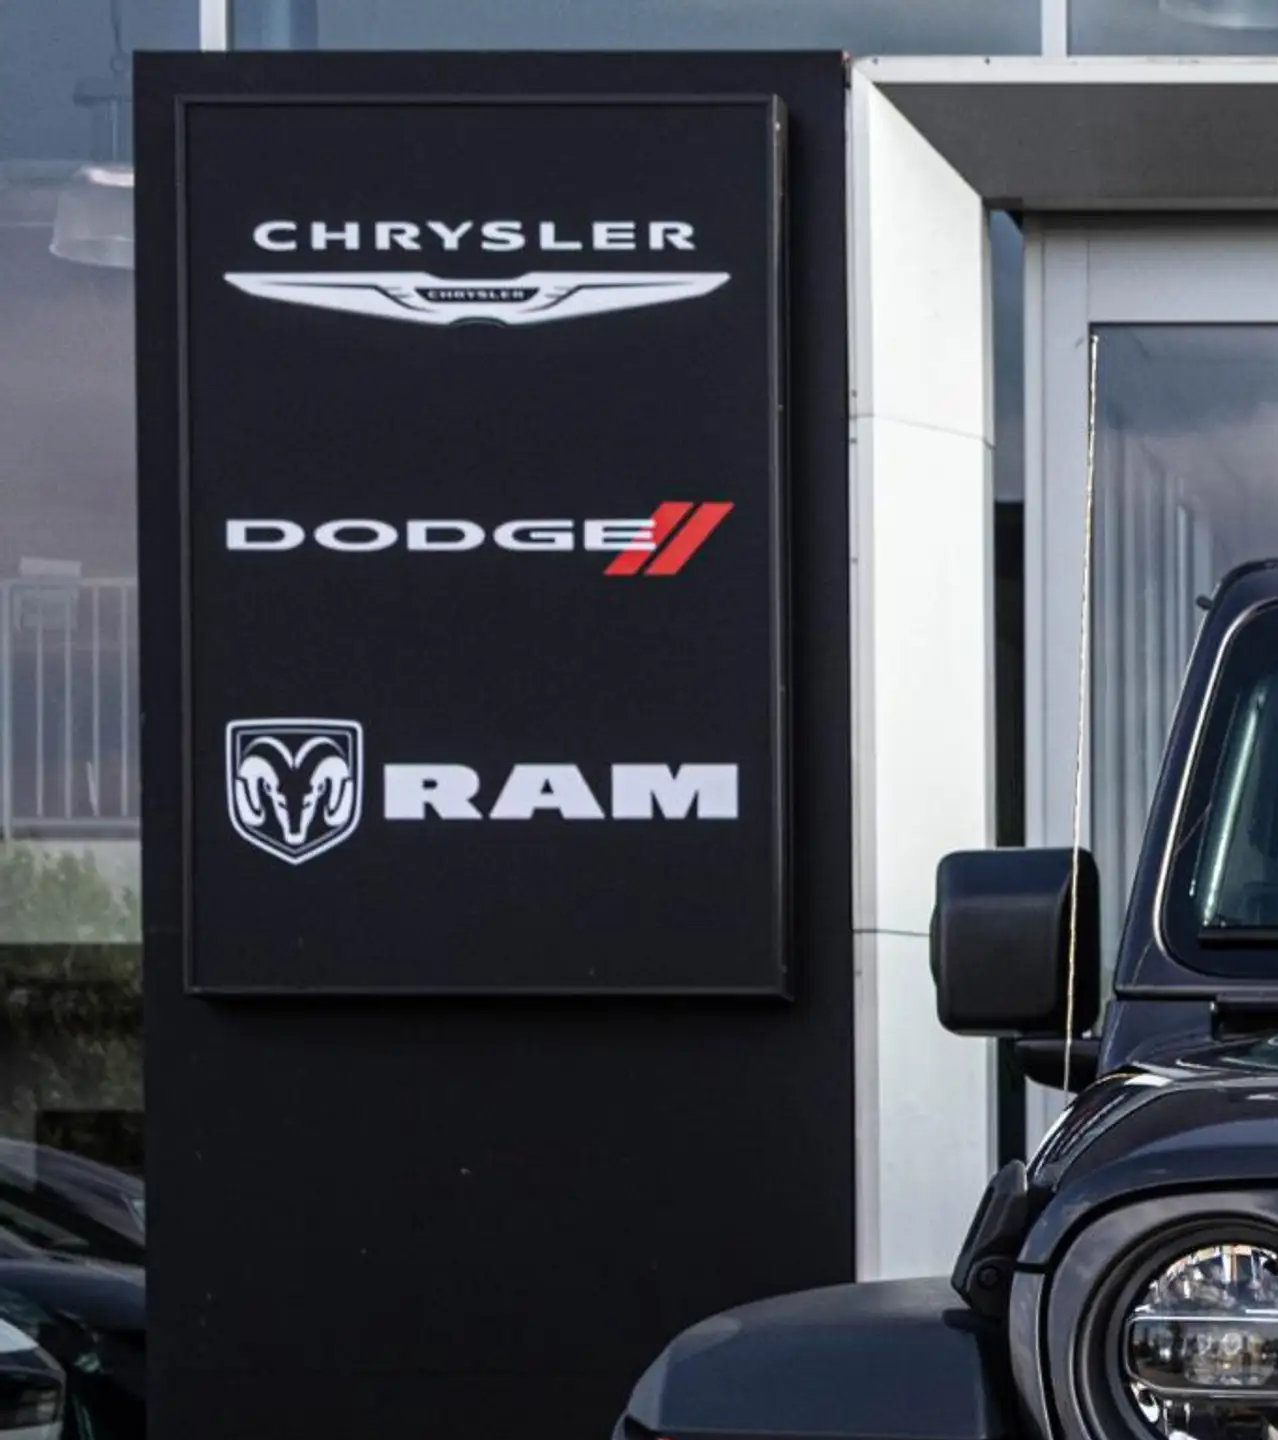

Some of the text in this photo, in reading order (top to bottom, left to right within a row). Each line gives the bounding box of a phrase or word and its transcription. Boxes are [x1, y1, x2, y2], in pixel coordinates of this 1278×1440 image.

[253, 220, 696, 252] CHRYSLER
[427, 289, 525, 300] CHRYSLER
[226, 519, 657, 552] DODGE
[383, 763, 739, 820] RAM
